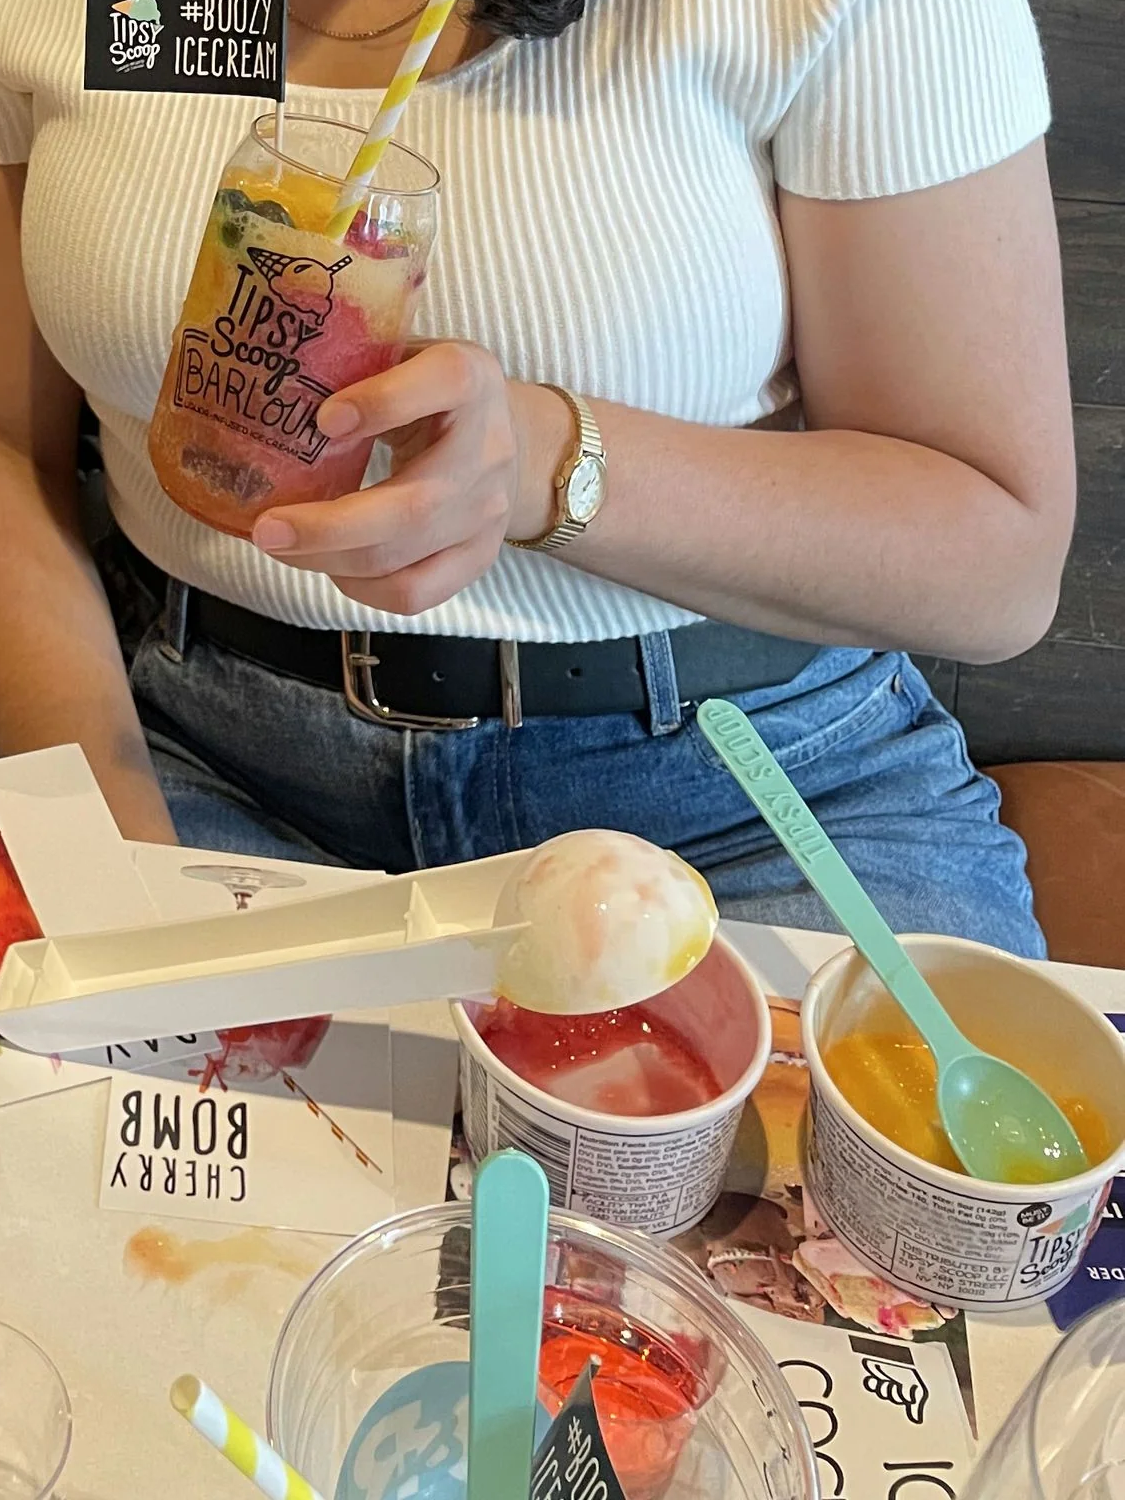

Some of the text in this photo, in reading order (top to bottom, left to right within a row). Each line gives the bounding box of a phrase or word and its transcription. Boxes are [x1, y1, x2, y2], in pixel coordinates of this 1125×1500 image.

[109, 13, 165, 46] TIPSY
[109, 41, 160, 70] Scoop
[174, 37, 277, 81] ICECREAM
[229, 264, 324, 354] TIPSY
[211, 316, 301, 396] Scoop
[704, 707, 828, 864] TIPSY SCOOP
[120, 1090, 248, 1160] BOMB
[110, 1152, 246, 1202] CHERRY
[938, 1266, 982, 1279] SCOOP
